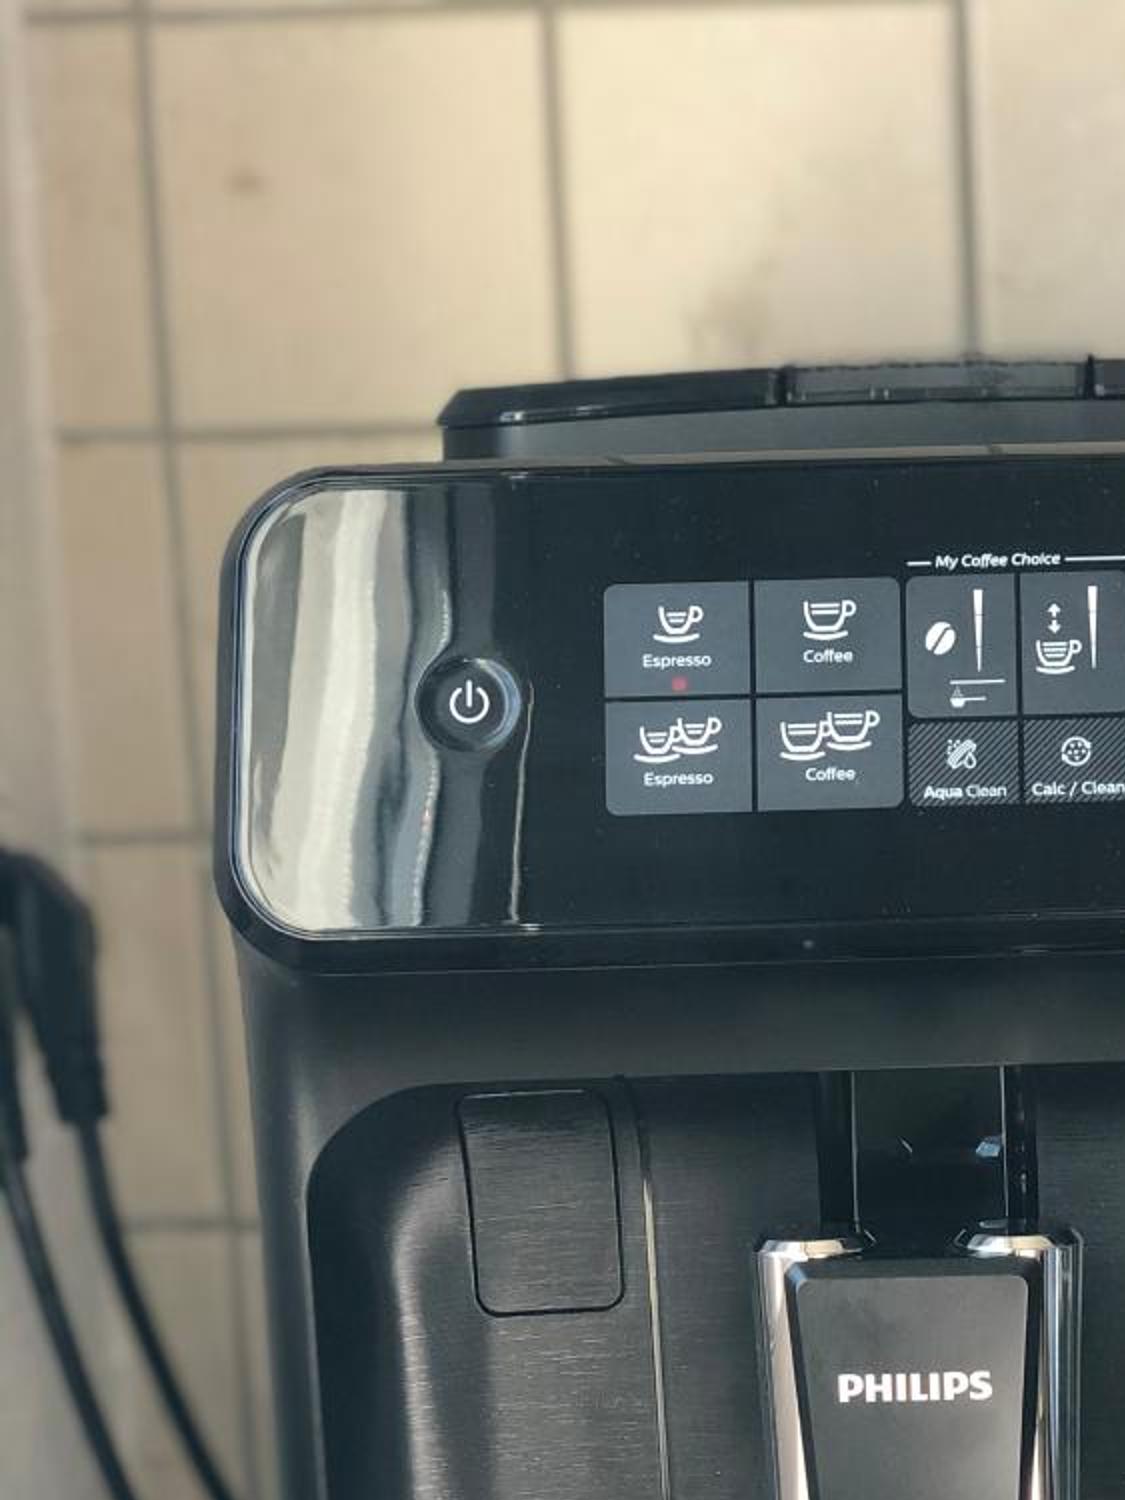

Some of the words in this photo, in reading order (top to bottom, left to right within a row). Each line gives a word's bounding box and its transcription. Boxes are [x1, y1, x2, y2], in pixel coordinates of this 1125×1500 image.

[935, 555, 957, 571] My
[961, 554, 1008, 568] Coffee
[1011, 552, 1061, 567] Choice
[642, 654, 712, 670] Espresso
[803, 649, 854, 663] Coffee
[643, 772, 714, 788] Espresso
[805, 767, 856, 781] Coffee
[924, 785, 963, 802] Aqua
[966, 784, 1007, 798] Clean
[1031, 781, 1066, 797] Calc
[837, 1370, 993, 1403] PHILIPS
